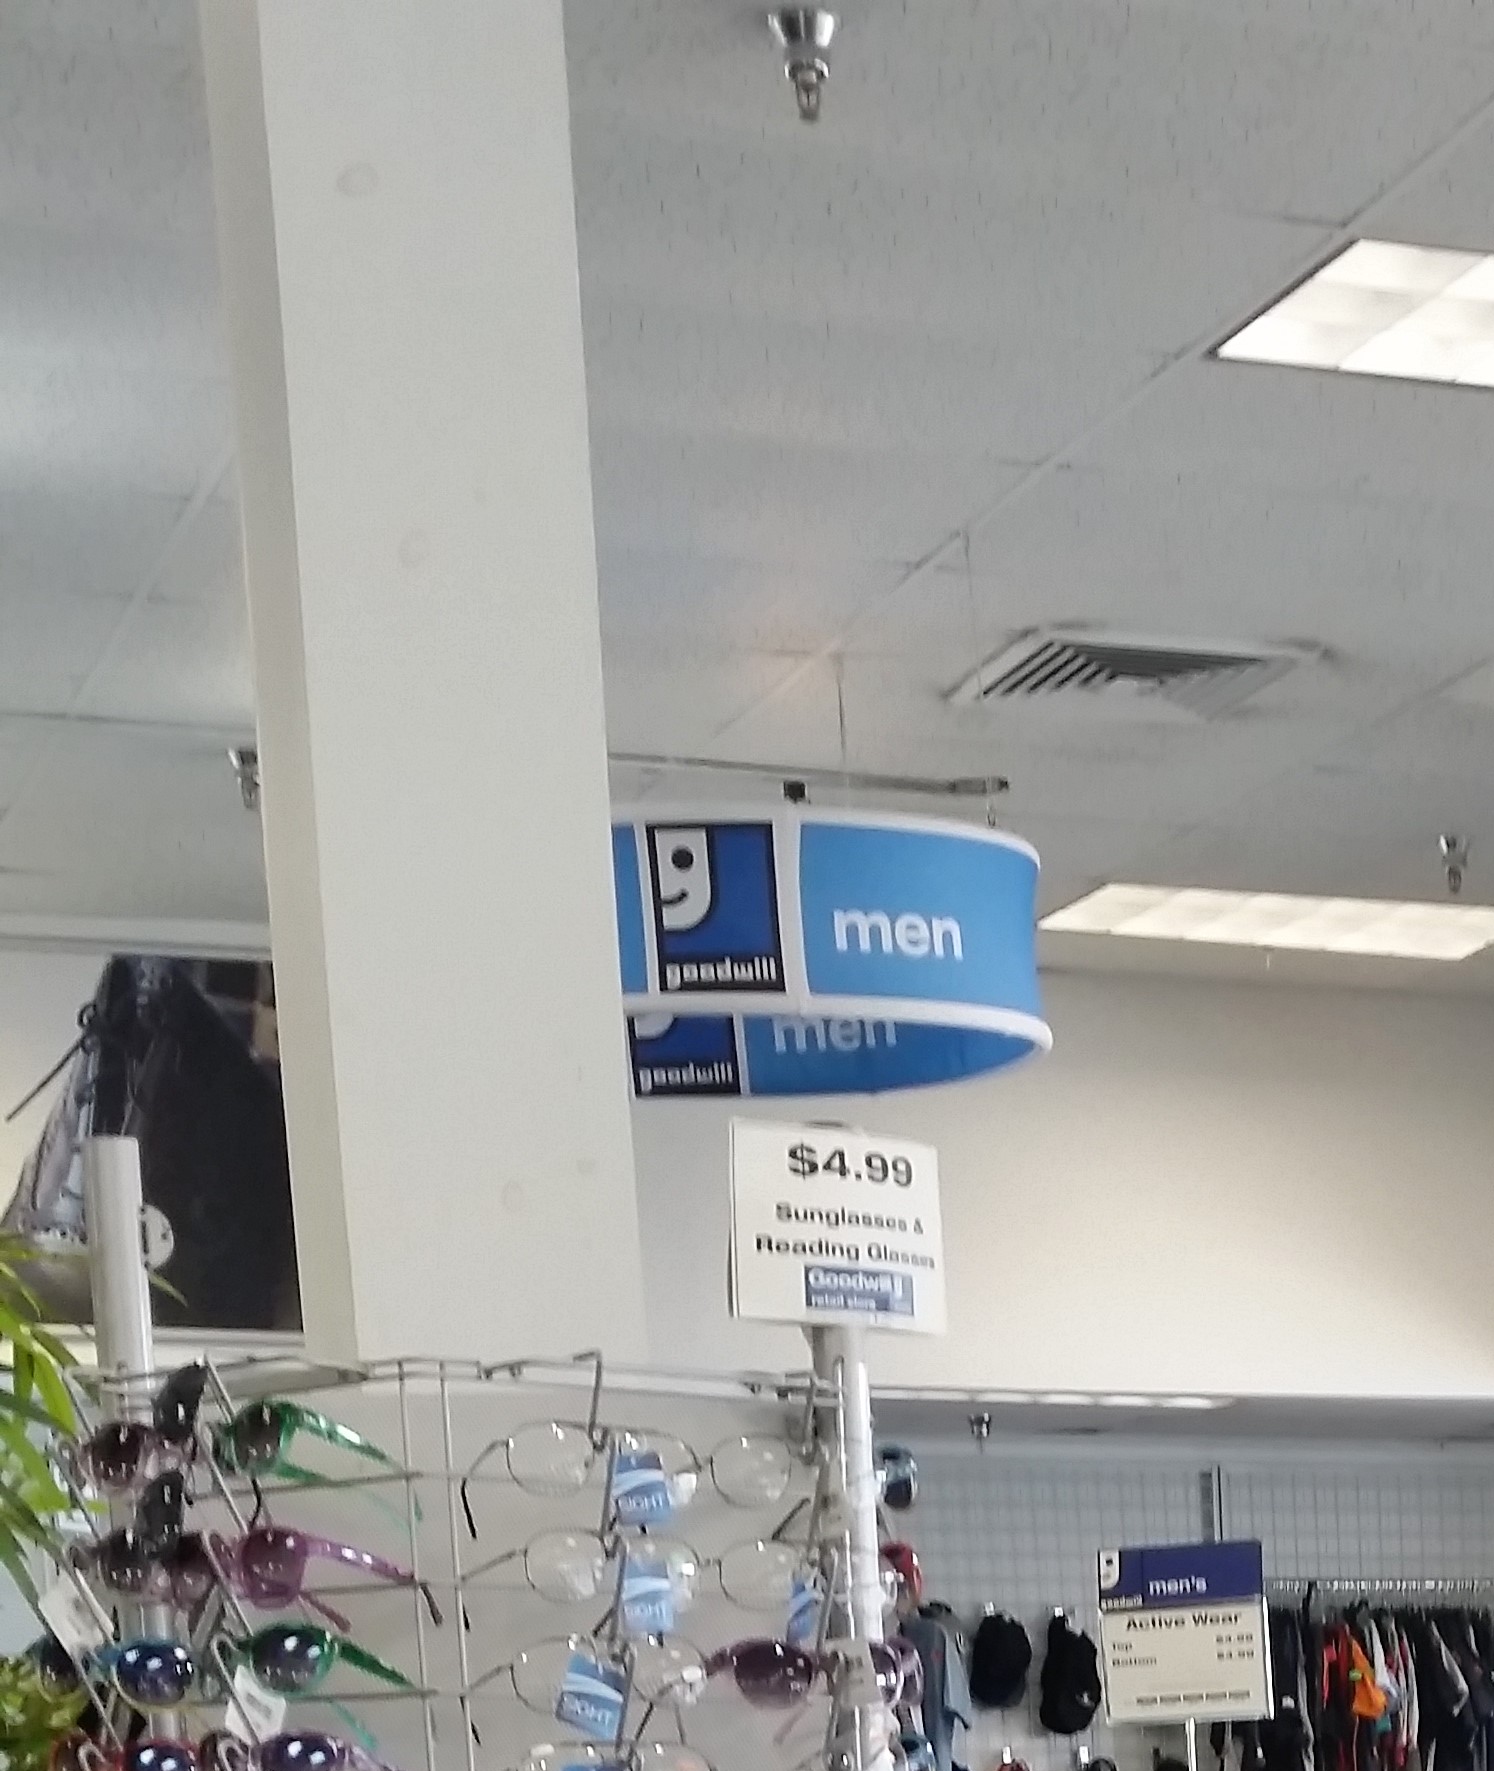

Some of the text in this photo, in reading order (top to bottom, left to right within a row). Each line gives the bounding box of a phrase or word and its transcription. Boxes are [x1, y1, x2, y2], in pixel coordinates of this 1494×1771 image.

[832, 907, 965, 963] men
[666, 957, 776, 990] goodwill
[638, 1060, 734, 1095] goodwill
[786, 1141, 914, 1189] $4.99
[774, 1201, 909, 1233] Sunglasses
[754, 1232, 936, 1270] Reading Glasses
[1149, 1575, 1208, 1596] men's
[1126, 1611, 1239, 1633] Active Wear
